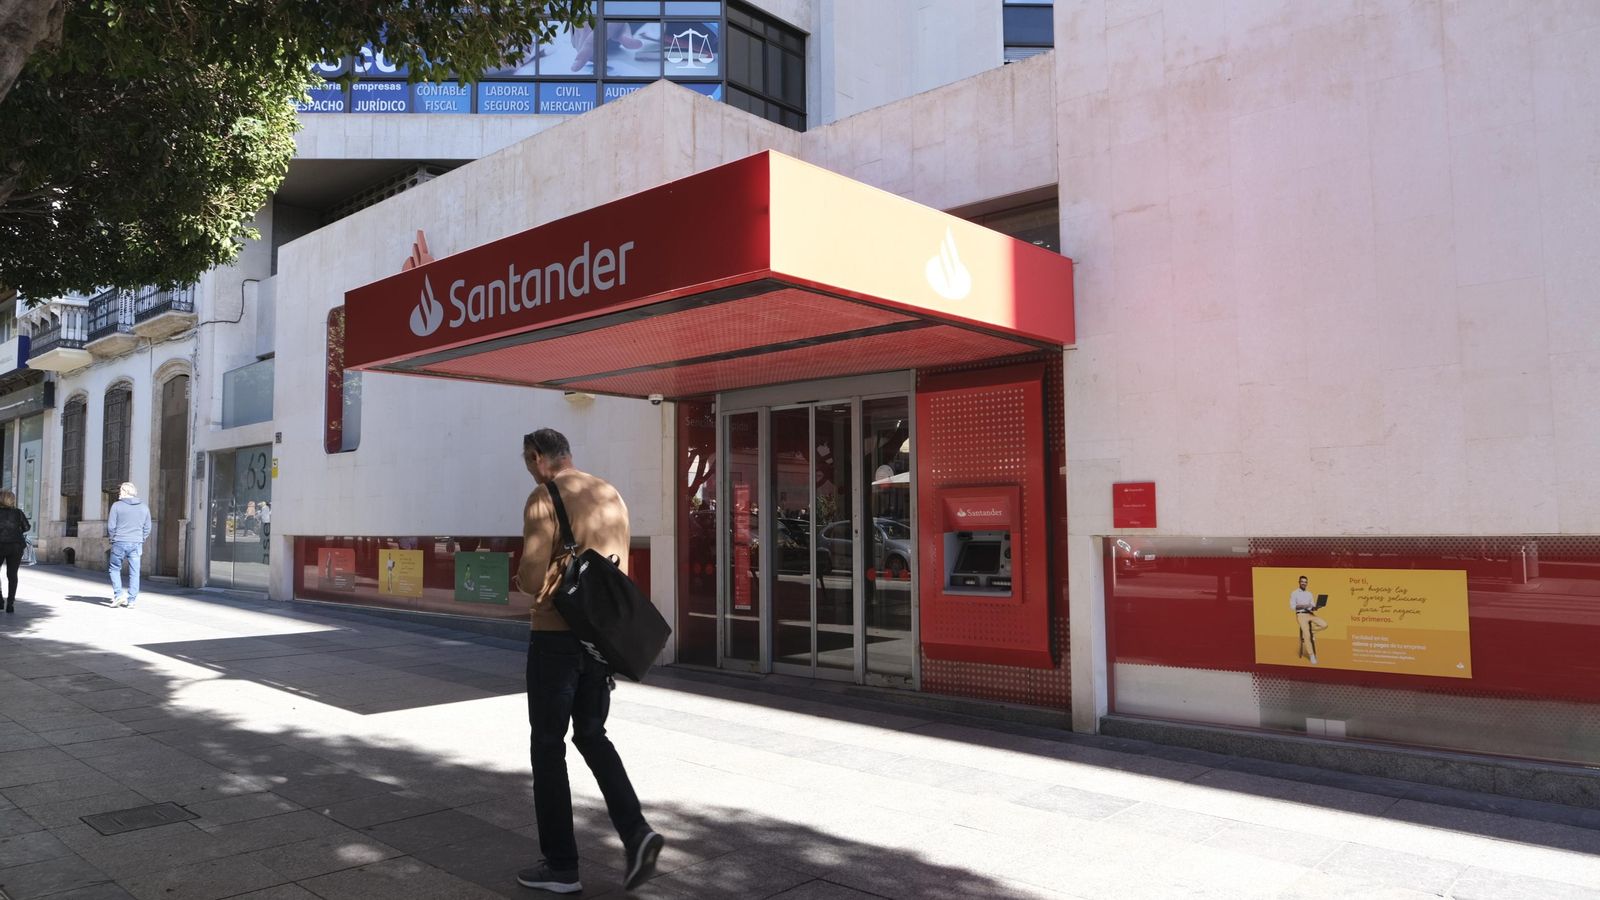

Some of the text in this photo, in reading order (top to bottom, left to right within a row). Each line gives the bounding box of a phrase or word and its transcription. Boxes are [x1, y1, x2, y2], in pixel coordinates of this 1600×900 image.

[352, 82, 402, 92] empresas
[416, 85, 467, 97] CONTABLE
[485, 85, 530, 97] LABORAL
[555, 86, 581, 97] CIVIL
[605, 87, 640, 98] AUDIT
[296, 98, 406, 112] ESPACHO JURÍDICO
[425, 100, 458, 111] FISCAL
[484, 100, 530, 112] SEGUROS
[450, 240, 635, 329] Santander
[246, 451, 267, 490] 63
[967, 507, 1002, 517] Santander
